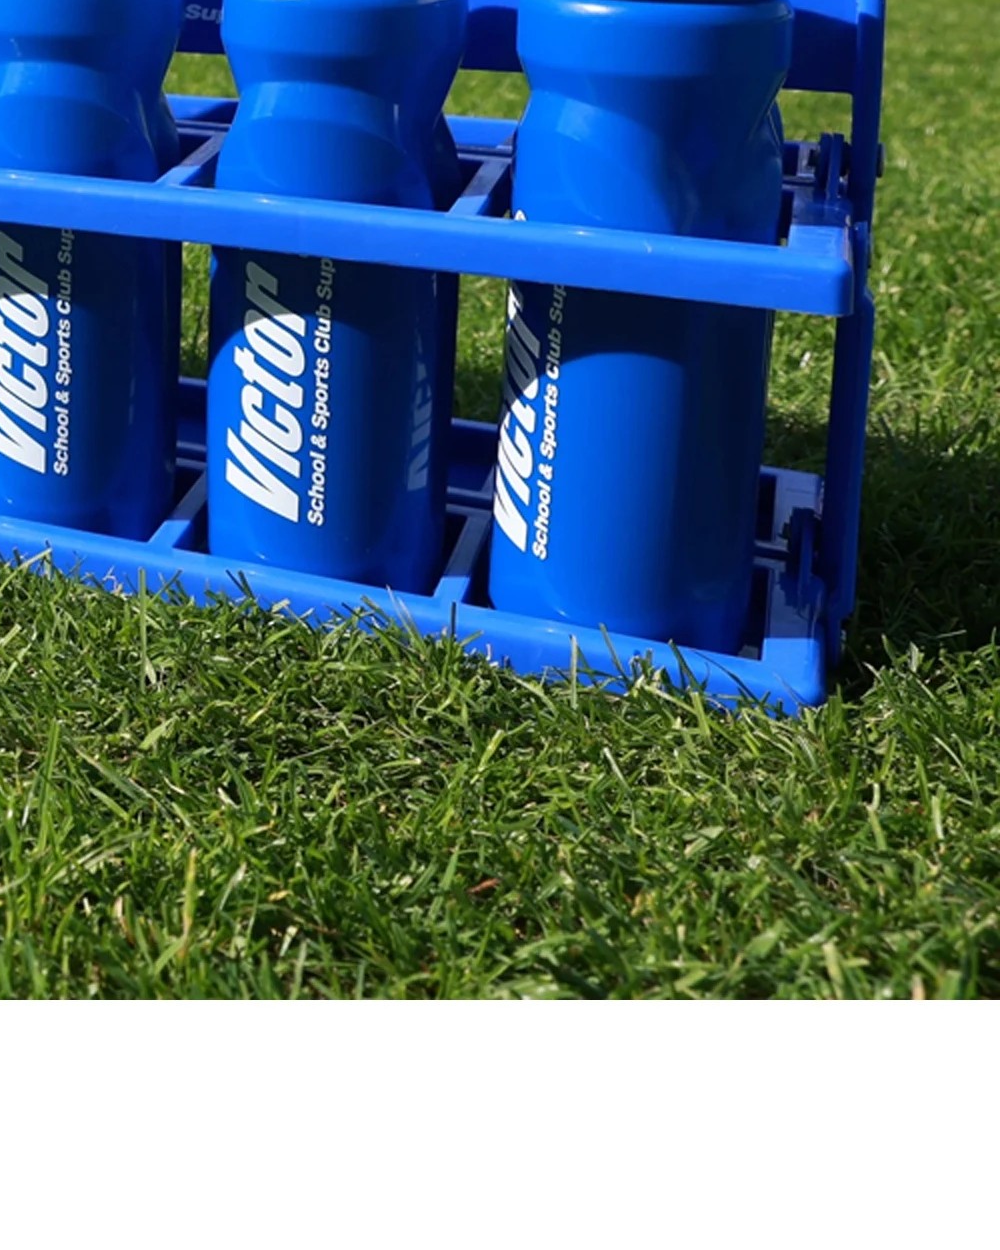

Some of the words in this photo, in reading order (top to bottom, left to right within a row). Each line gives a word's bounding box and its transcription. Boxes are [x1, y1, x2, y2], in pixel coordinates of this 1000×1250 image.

[56, 269, 71, 315] Club
[55, 318, 72, 386] Sports
[314, 304, 331, 353] Club
[545, 329, 562, 380] Club
[55, 390, 70, 405] &
[225, 261, 306, 523] Victor
[311, 357, 330, 430] Sports
[541, 382, 559, 460] Sports
[53, 407, 69, 476] School
[310, 434, 327, 449] &
[539, 463, 554, 480] &
[307, 451, 327, 527] School
[532, 480, 552, 561] School
